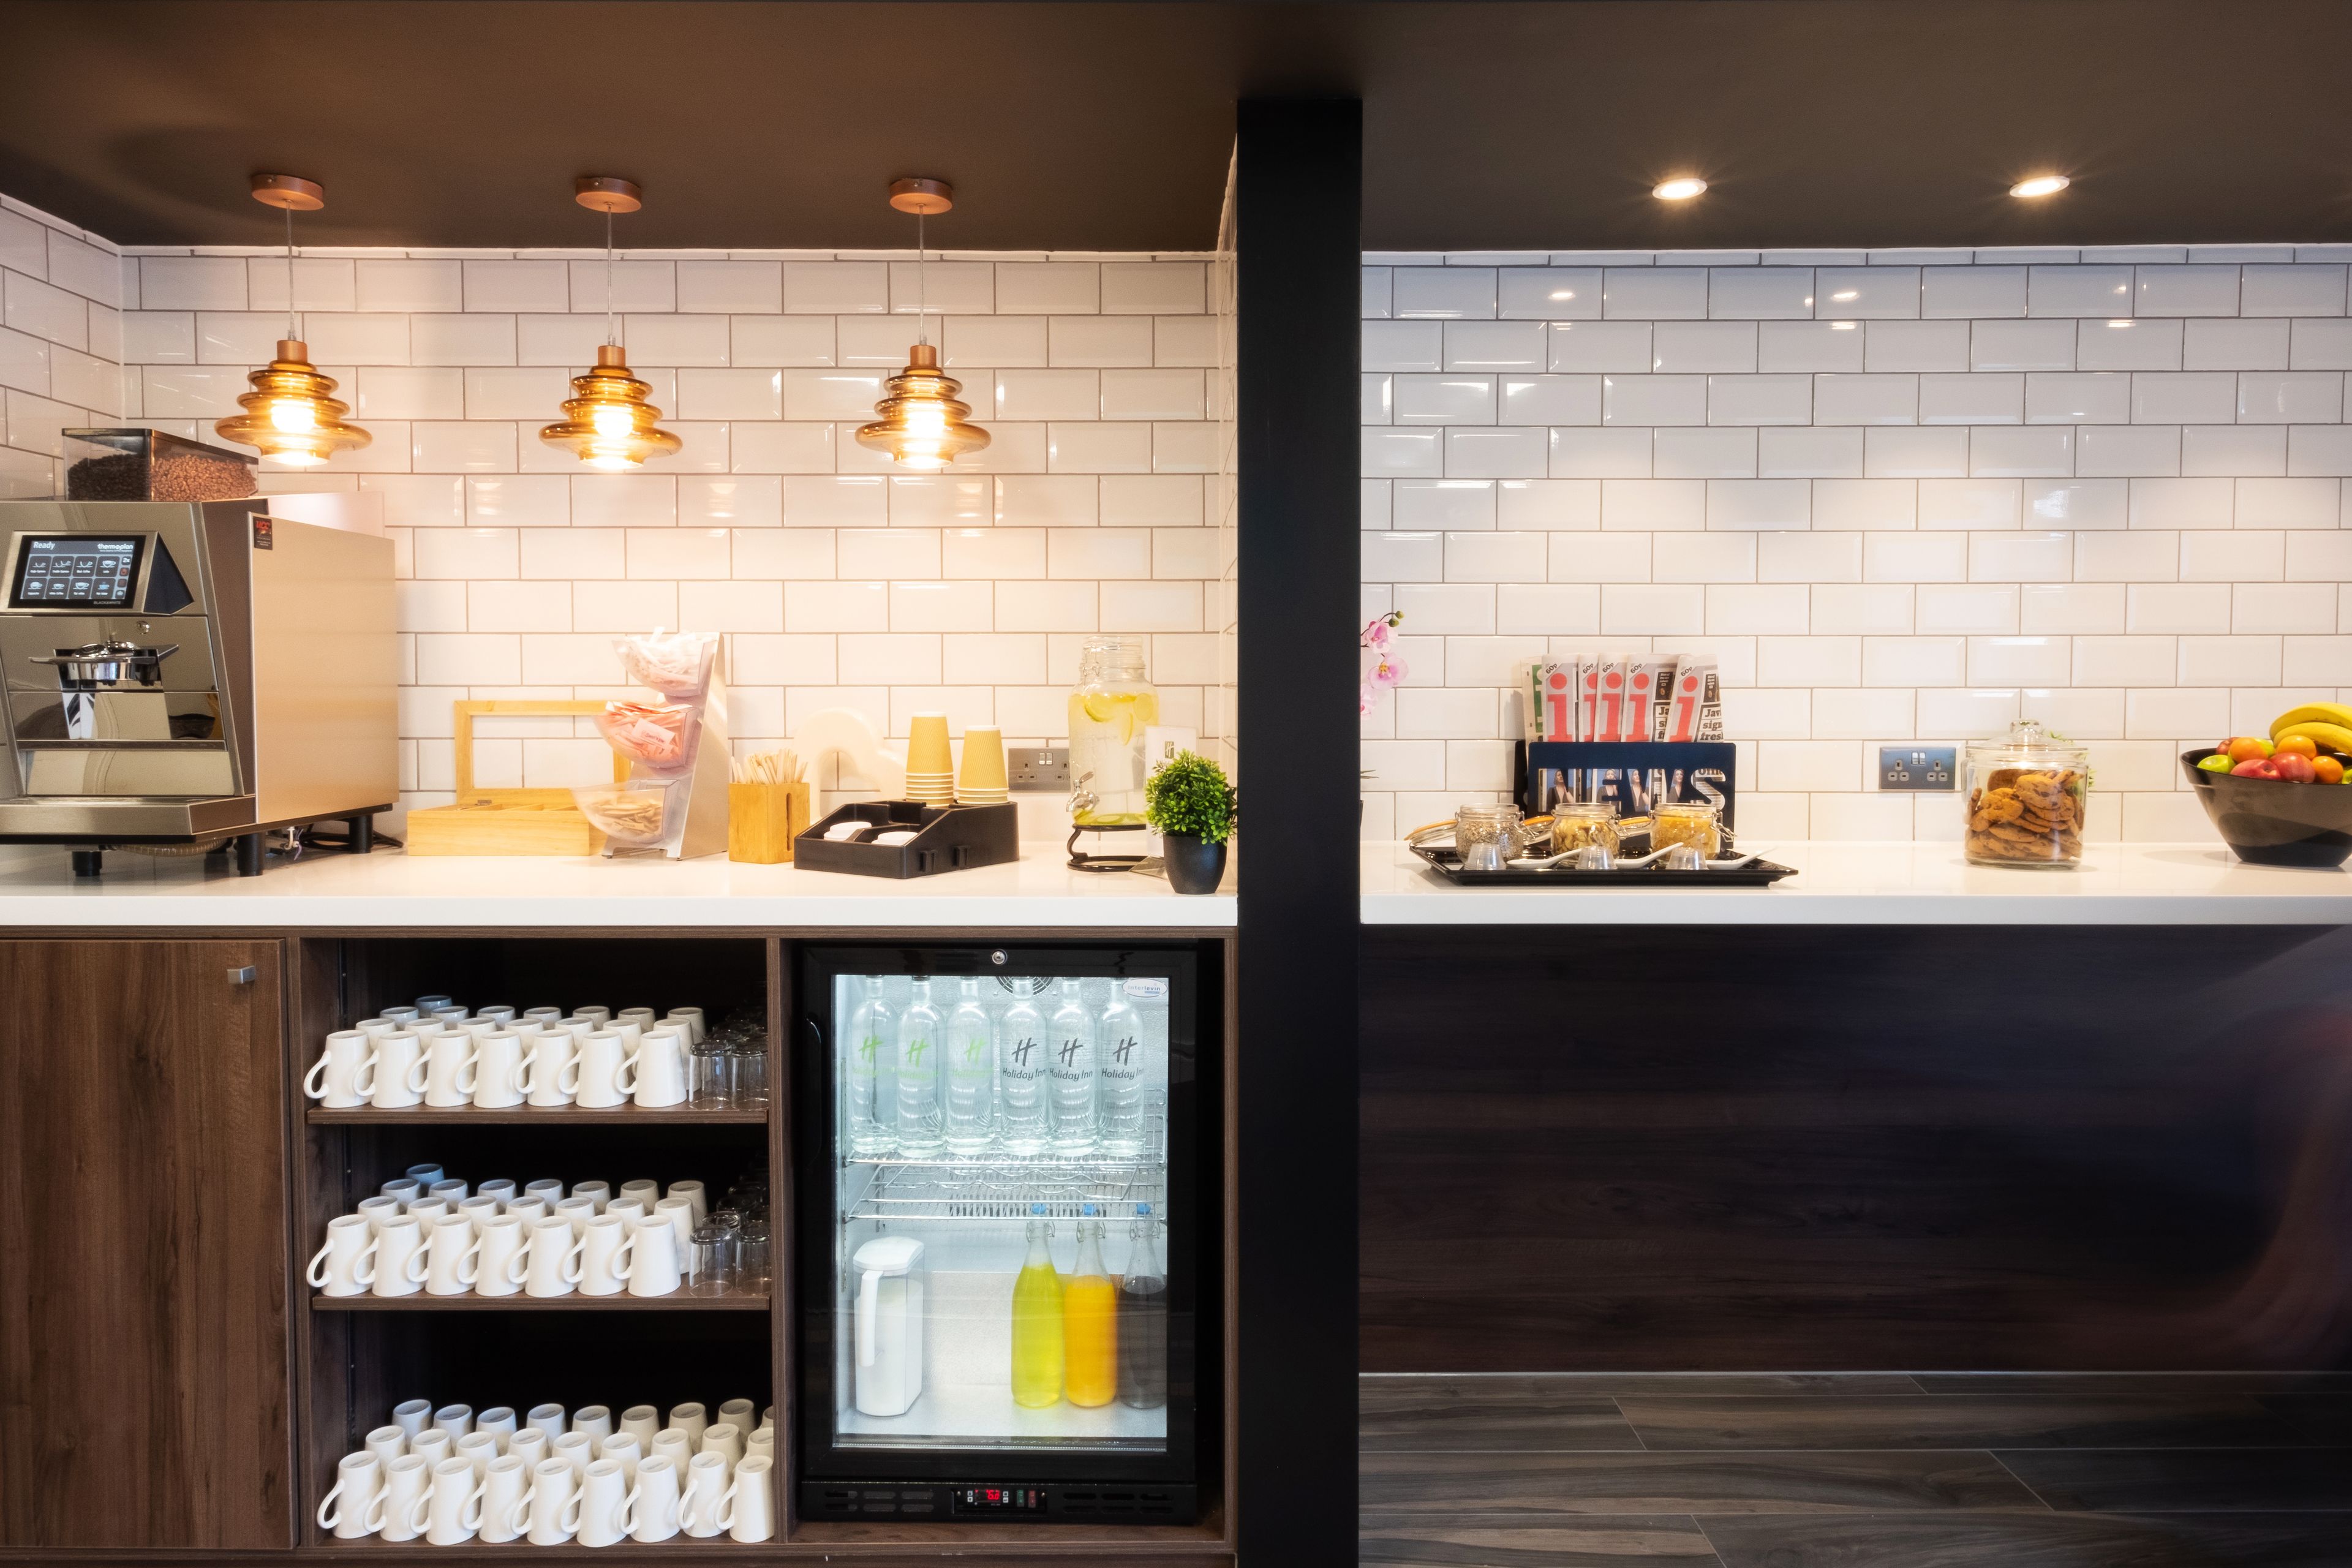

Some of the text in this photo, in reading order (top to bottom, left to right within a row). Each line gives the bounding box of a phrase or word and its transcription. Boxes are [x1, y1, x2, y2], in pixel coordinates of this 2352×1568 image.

[33, 541, 55, 550] Ready
[1545, 663, 1558, 674] 60p
[1583, 663, 1594, 674] 60p
[1602, 663, 1614, 673] 60p
[1630, 663, 1642, 674] 60p
[1680, 667, 1692, 676] 60p
[1547, 673, 1573, 742] i
[1599, 672, 1623, 742] i
[1626, 673, 1649, 742] i
[1669, 676, 1698, 742] i
[1538, 768, 1727, 812] NEWS
[1002, 1068, 1046, 1080] Holiday Inn
[1050, 1068, 1093, 1082] Holiday Inn
[1101, 1068, 1135, 1079] Holiday
